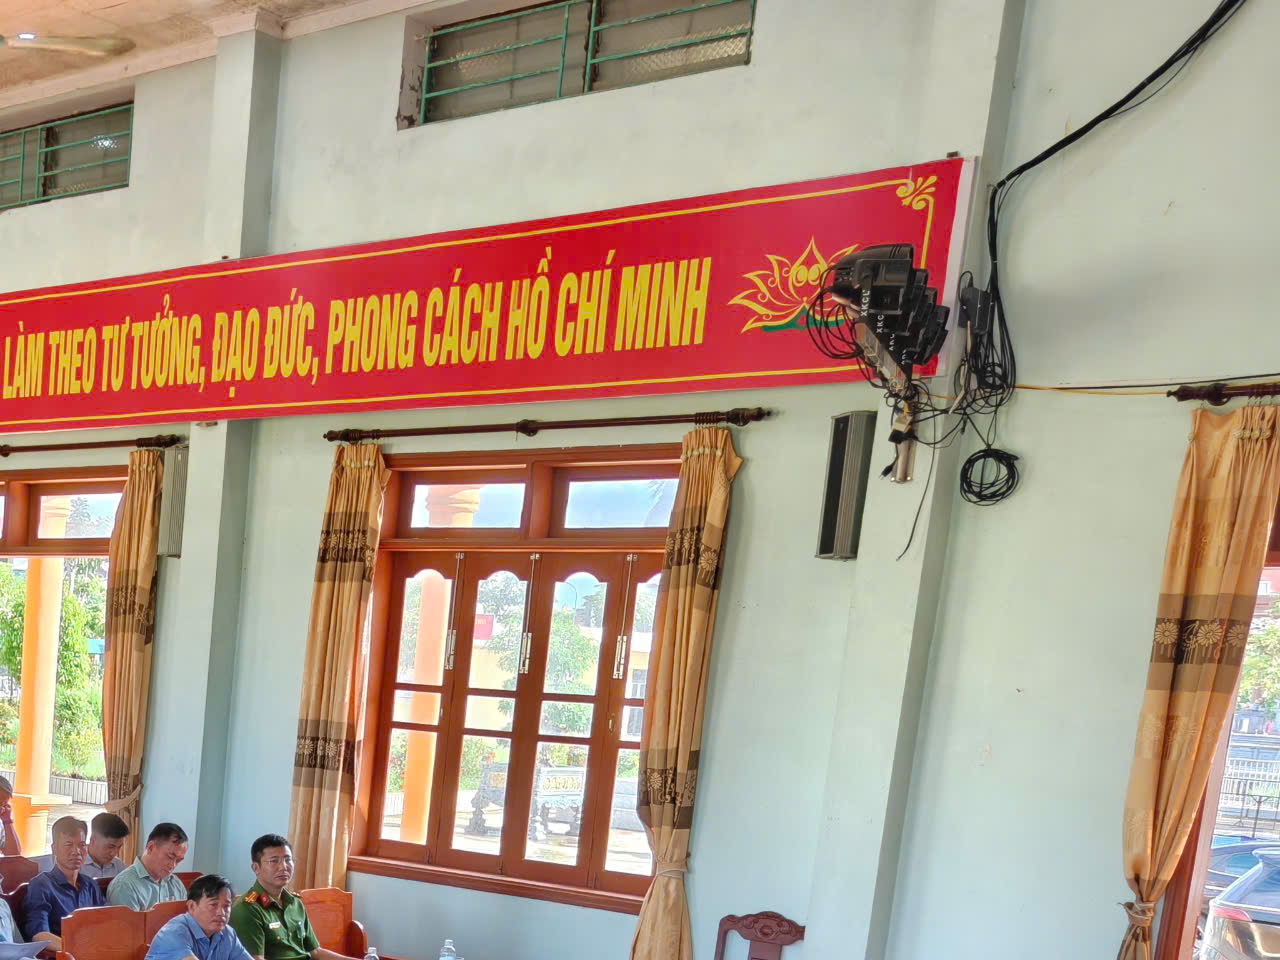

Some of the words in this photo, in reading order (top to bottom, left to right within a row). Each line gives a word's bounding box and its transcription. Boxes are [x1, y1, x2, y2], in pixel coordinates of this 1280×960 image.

[3, 321, 44, 399] LÀM
[48, 326, 96, 397] THEO
[101, 315, 131, 392] TƯ
[131, 294, 204, 392] TƯỞNG,
[211, 308, 259, 398] ĐẠO
[263, 288, 318, 385] ĐỨC,
[325, 290, 418, 373] PHONG
[422, 268, 504, 366] CÁCH
[505, 246, 552, 359] HỒ
[554, 249, 616, 356] CHÍ
[614, 256, 712, 351] MINH
